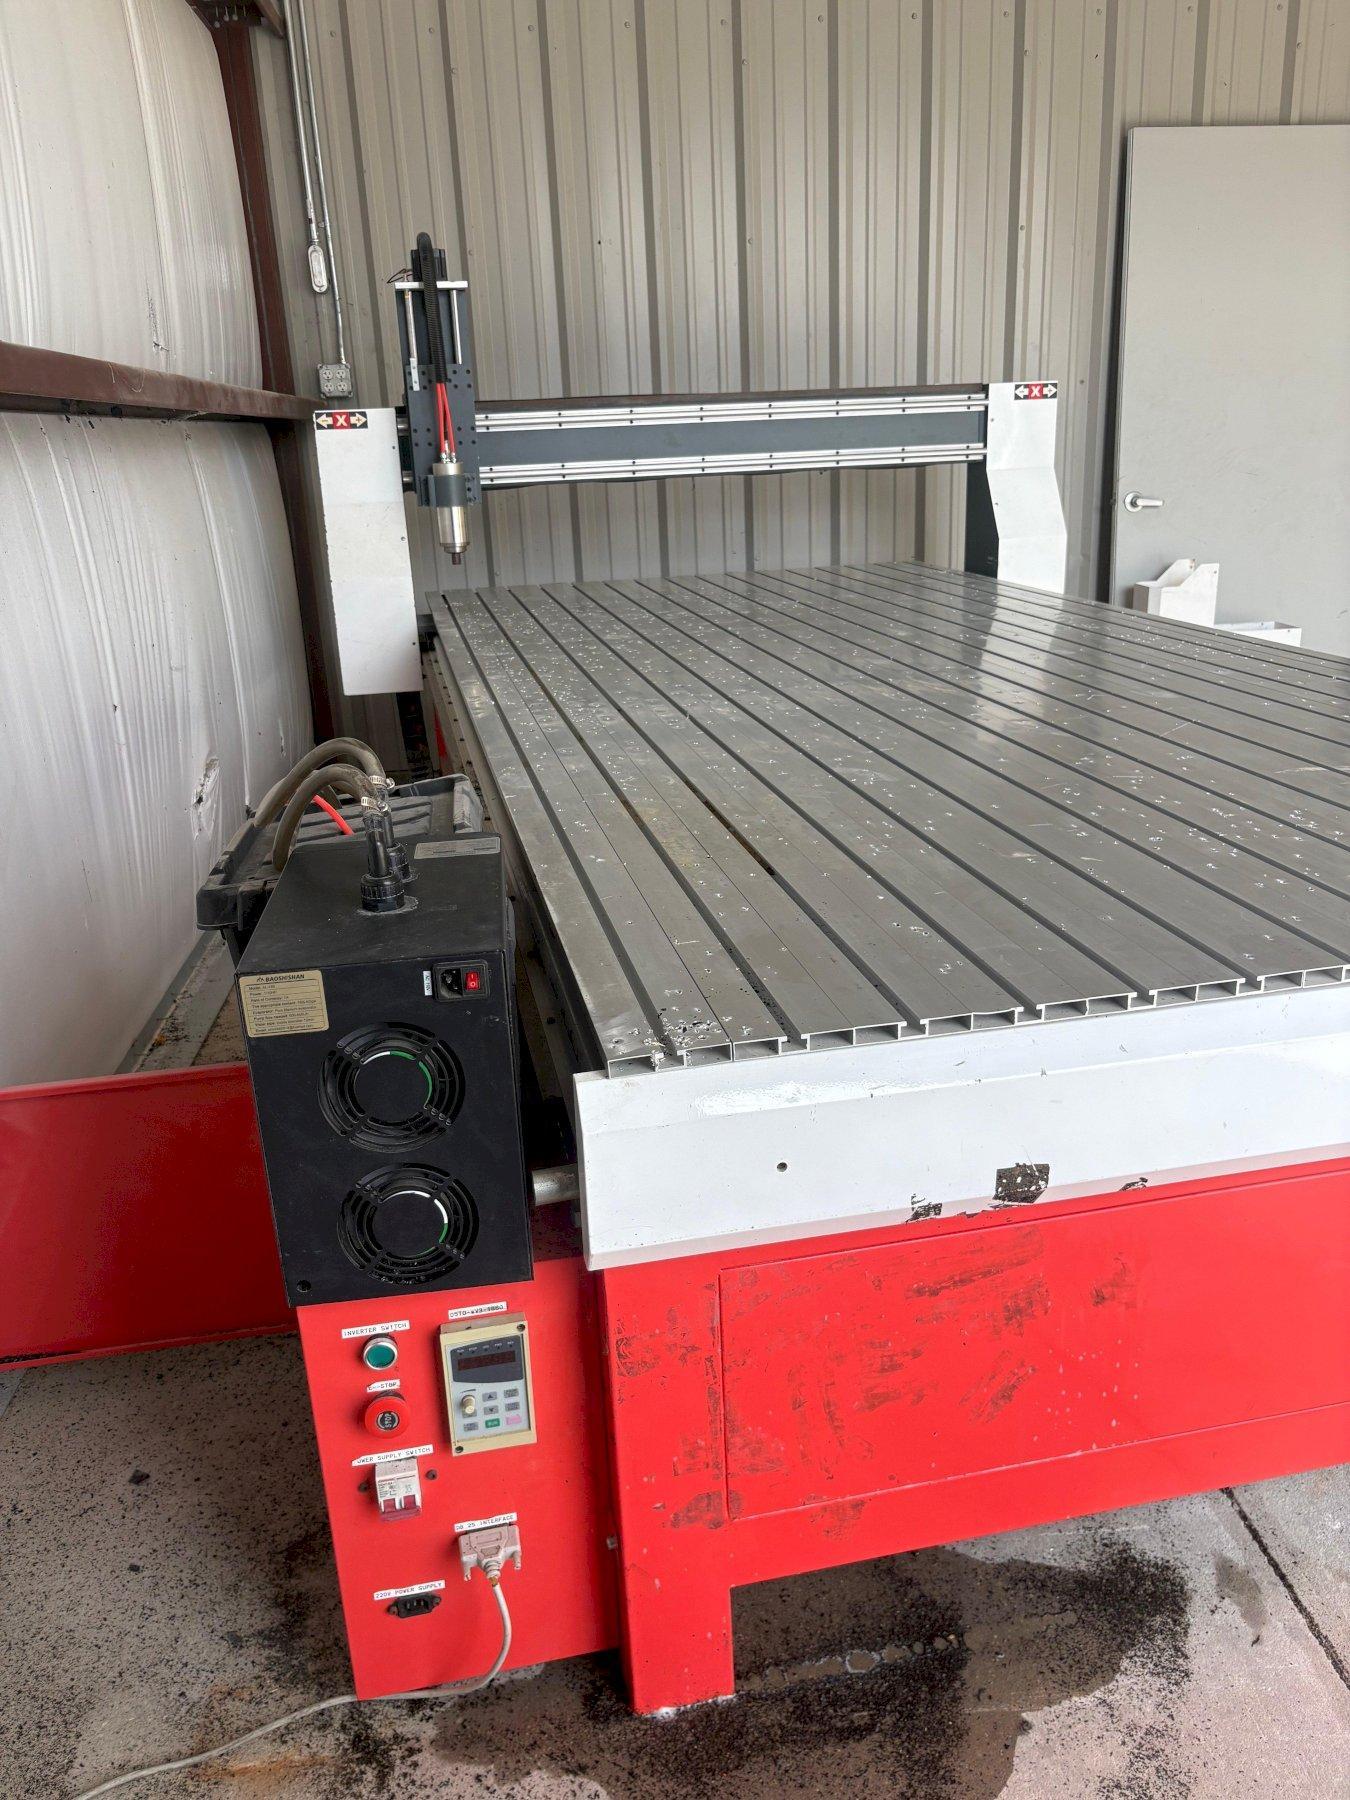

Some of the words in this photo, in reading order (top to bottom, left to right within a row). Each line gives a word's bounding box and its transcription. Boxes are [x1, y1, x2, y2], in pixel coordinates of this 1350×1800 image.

[1030, 385, 1042, 397] X
[335, 414, 348, 427] X
[343, 1327, 377, 1336] INVERTER
[380, 1322, 407, 1332] SWITCH
[377, 1452, 402, 1461] SUPPLY
[405, 1447, 431, 1455] SWITCH
[480, 1514, 514, 1526] INTERFACE
[394, 1587, 415, 1596] POWER
[418, 1582, 442, 1591] SUPPLY
